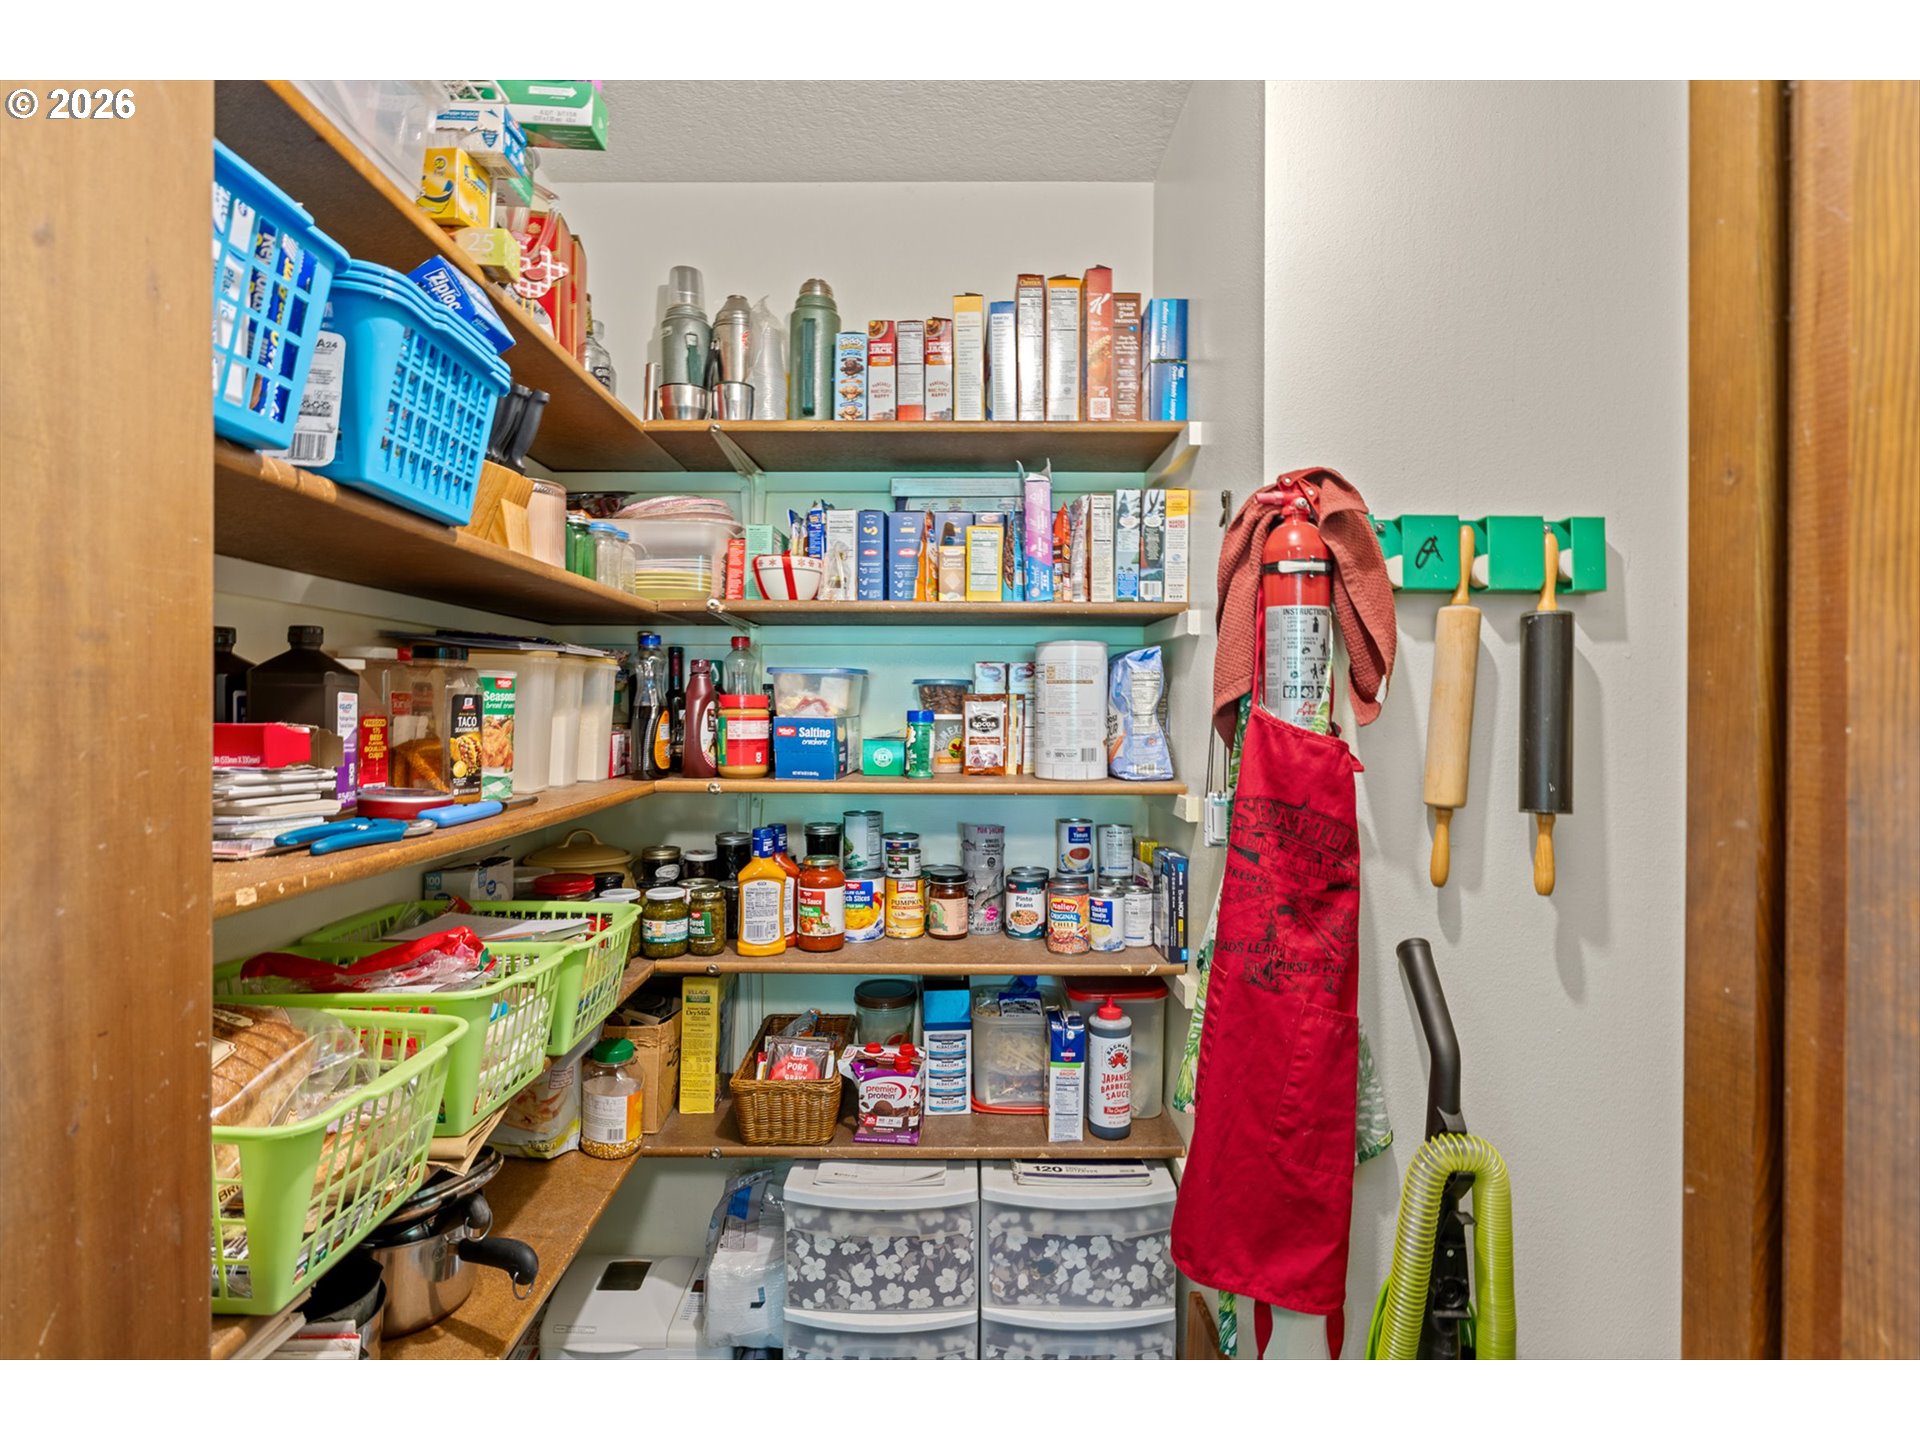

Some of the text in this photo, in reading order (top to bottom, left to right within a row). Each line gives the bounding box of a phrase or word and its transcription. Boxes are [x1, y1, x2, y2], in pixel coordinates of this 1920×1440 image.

[468, 231, 495, 252] 25
[429, 269, 462, 311] Ziploc
[870, 346, 894, 354] JACK
[928, 345, 952, 353] JACK
[457, 716, 478, 727] TACO
[798, 726, 832, 738] Saltine
[801, 738, 829, 746] crackers
[426, 876, 441, 885] 100
[1052, 903, 1076, 912] Nalley
[1050, 912, 1078, 920] ORIGINAL
[786, 1062, 808, 1072] PORK
[866, 1085, 898, 1094] premier
[868, 1092, 897, 1100] protein
[1106, 1090, 1129, 1101] SAUCE
